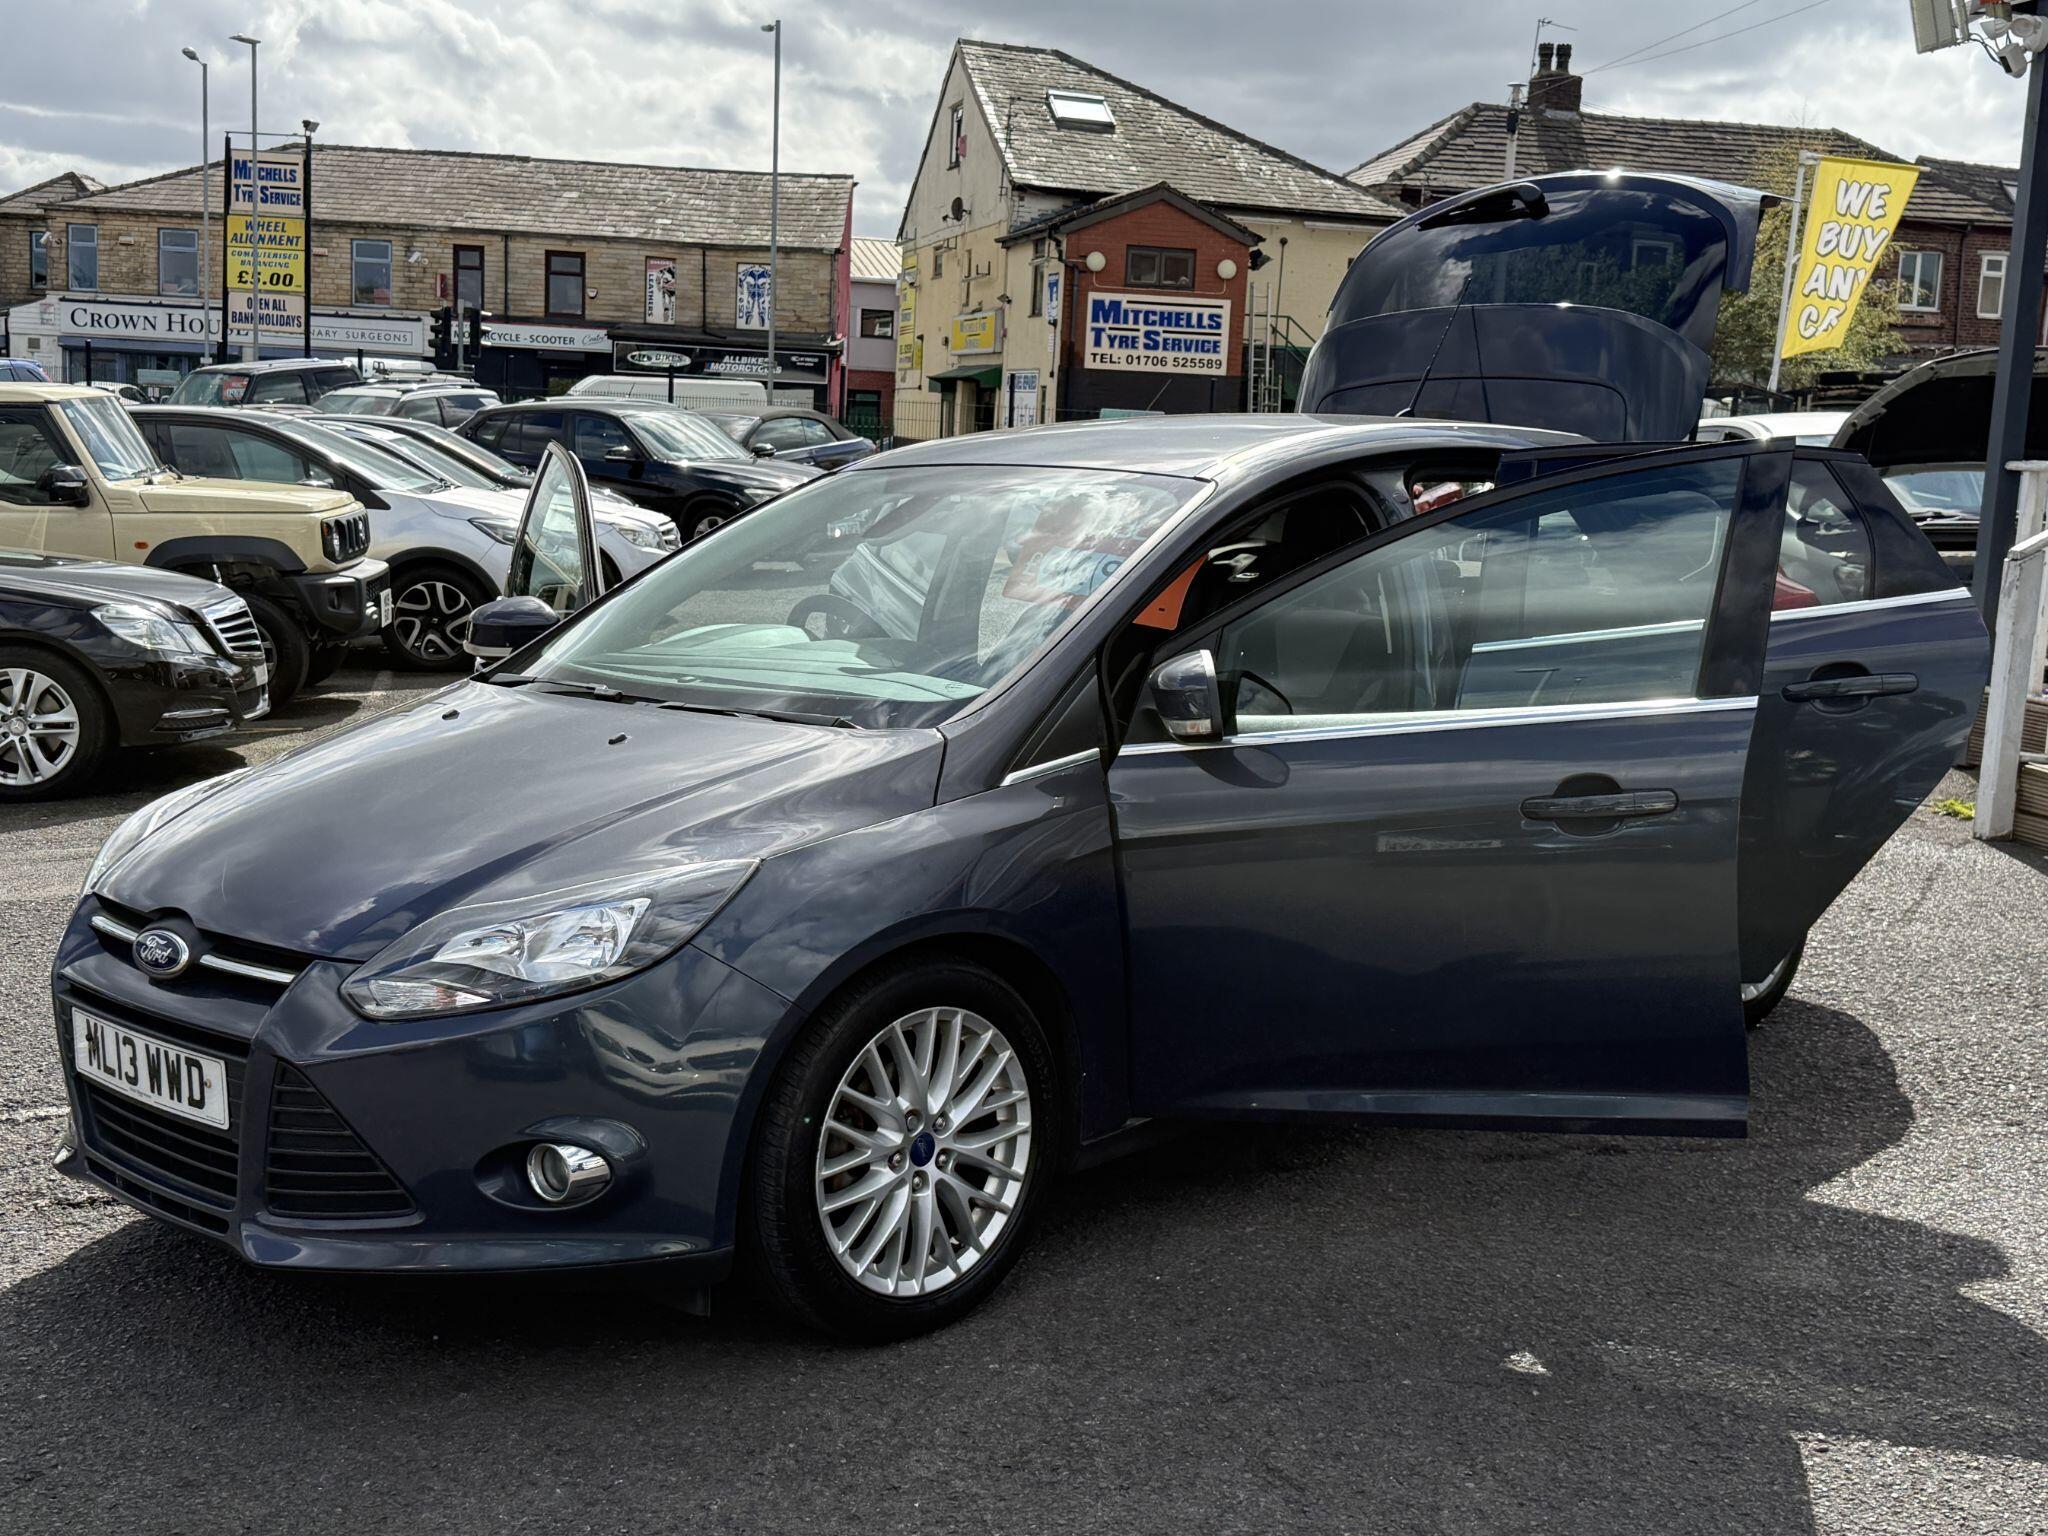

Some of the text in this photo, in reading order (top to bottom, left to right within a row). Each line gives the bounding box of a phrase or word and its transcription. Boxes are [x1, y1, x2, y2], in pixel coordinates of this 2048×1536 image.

[234, 159, 297, 183] MICHELLS
[234, 184, 301, 206] TYR SERVICE
[1836, 178, 1891, 220] WE
[1816, 220, 1890, 262] BUY
[247, 297, 287, 312] OEN ALL
[1091, 299, 1223, 330] MITCHELLS
[70, 307, 158, 331] CROWN
[258, 313, 302, 328] HOLIDAYS
[345, 331, 409, 343] SURGEONS
[529, 334, 576, 346] SCOOTER
[1091, 327, 1221, 354] TYRE SERVICE
[1090, 352, 1223, 370] TEL: 01706 525589
[140, 935, 173, 964] Ford
[145, 1043, 205, 1110] WWD
